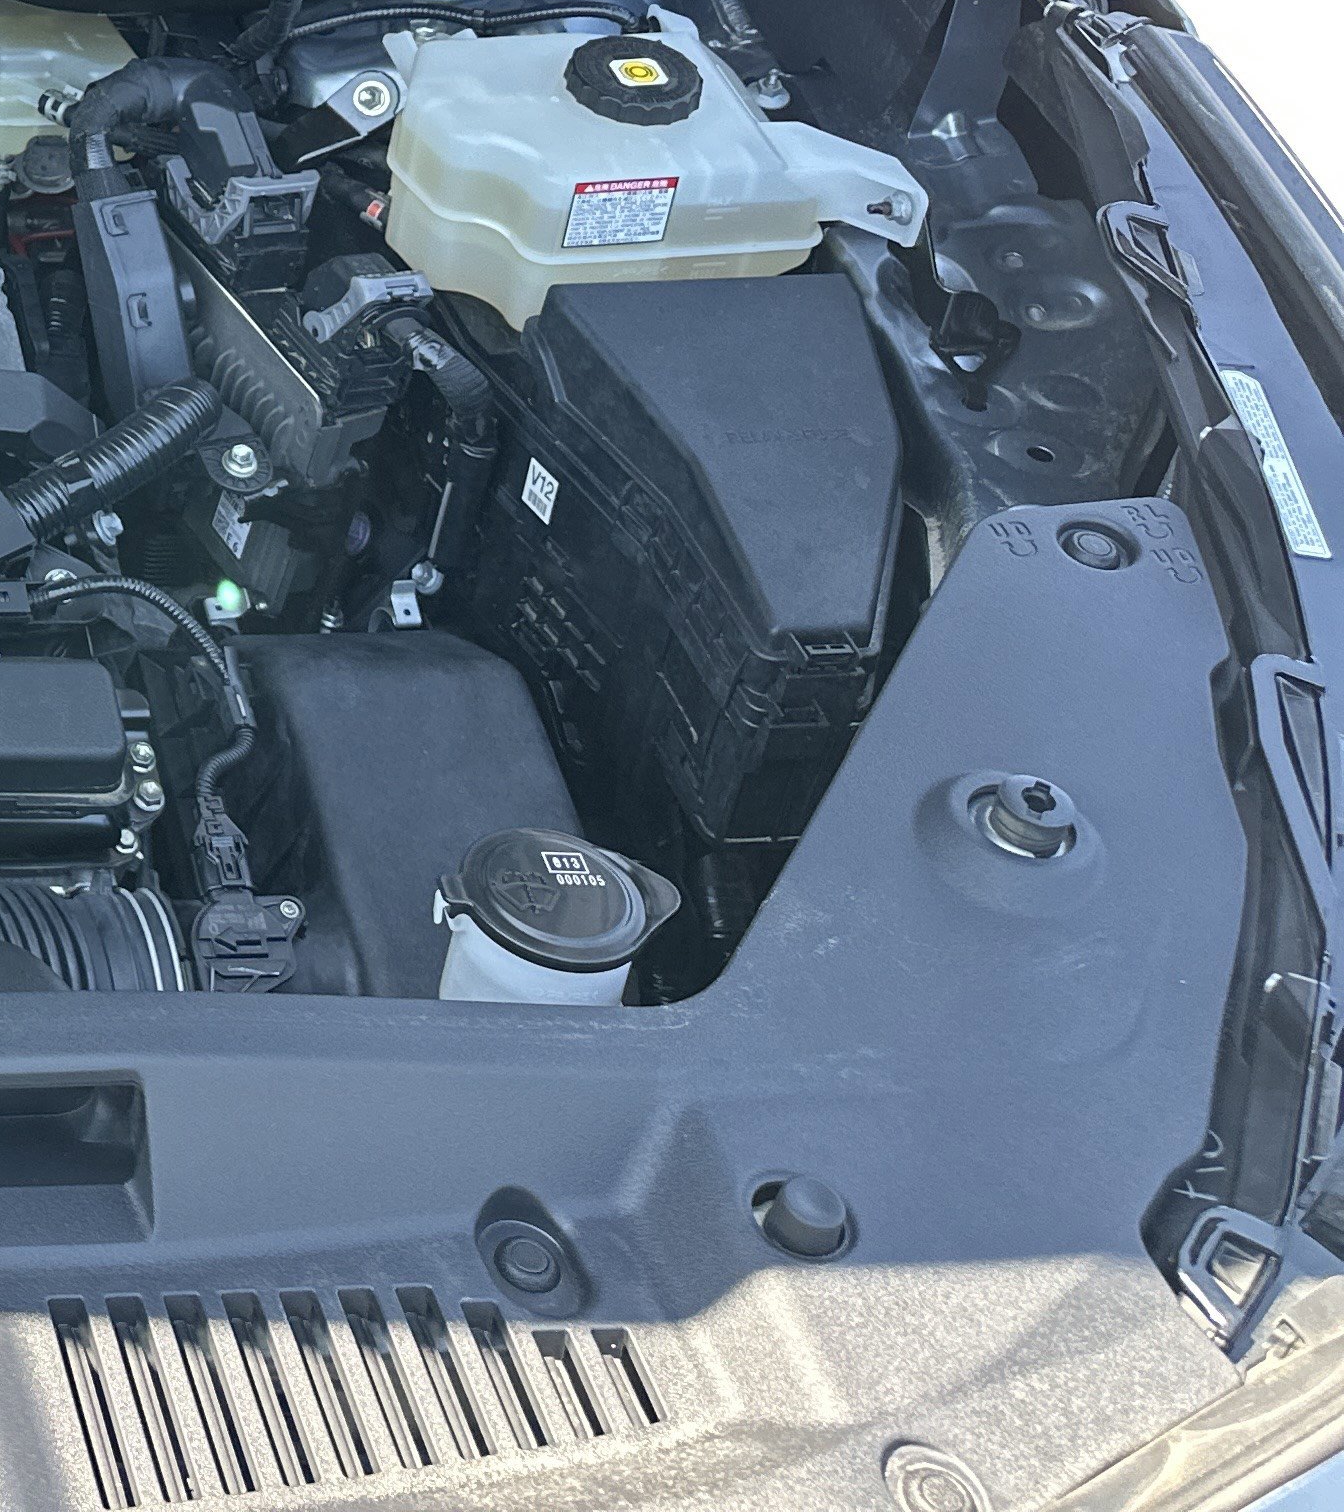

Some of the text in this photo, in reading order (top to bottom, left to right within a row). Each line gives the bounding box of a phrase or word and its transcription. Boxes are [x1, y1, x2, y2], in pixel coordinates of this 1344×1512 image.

[610, 180, 652, 191] DANGER
[532, 464, 554, 502] V12
[556, 873, 606, 886] 000105
